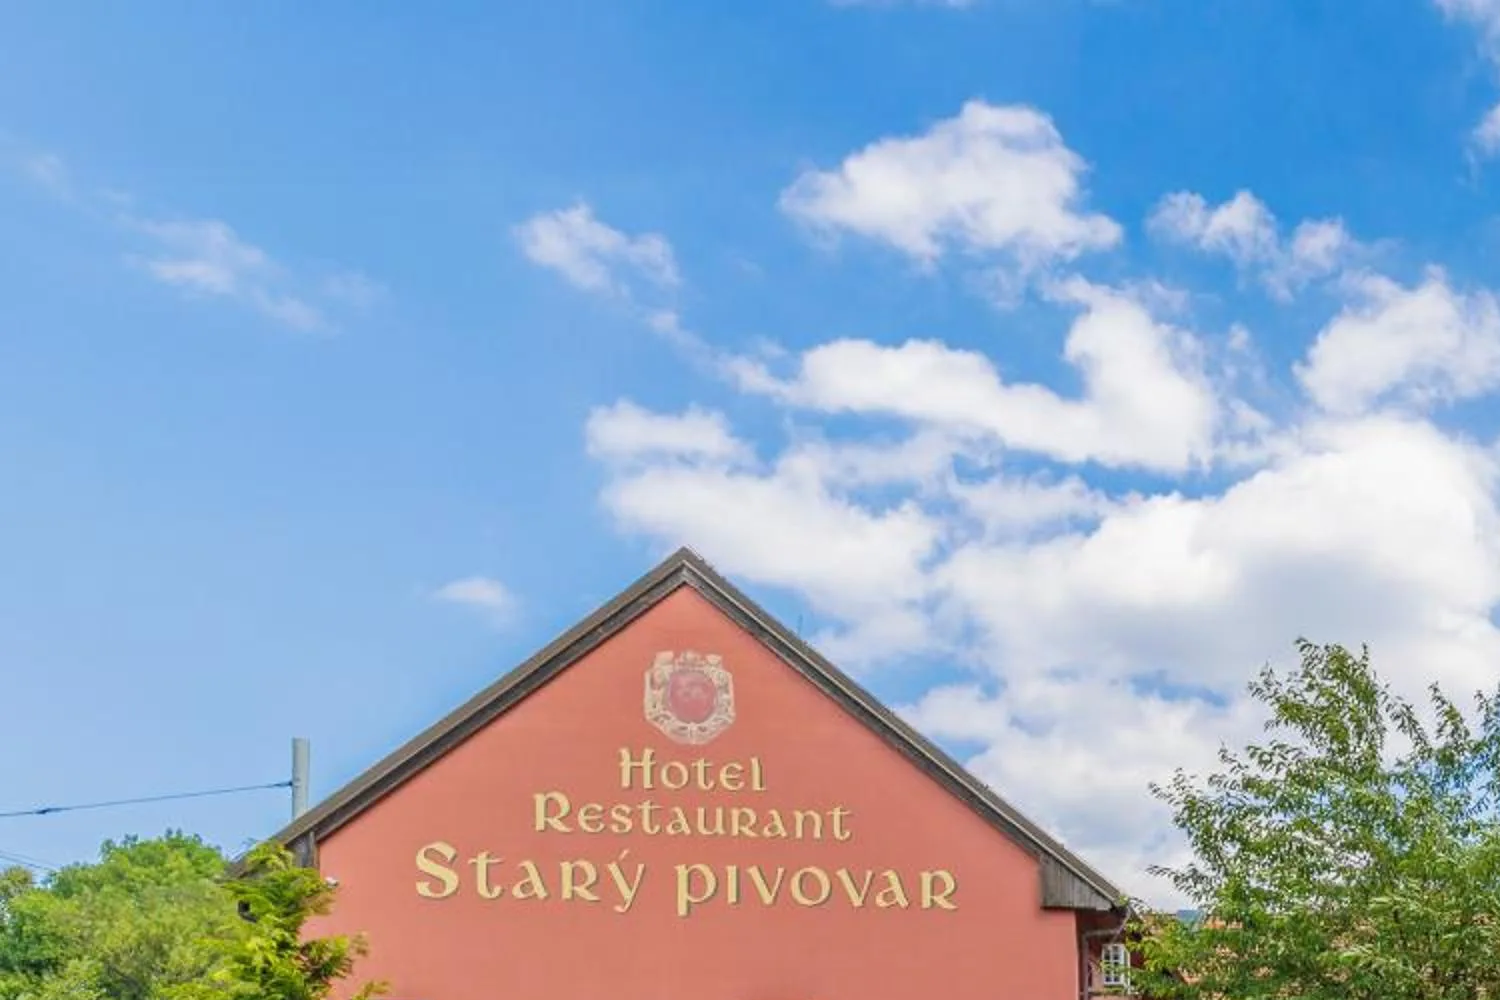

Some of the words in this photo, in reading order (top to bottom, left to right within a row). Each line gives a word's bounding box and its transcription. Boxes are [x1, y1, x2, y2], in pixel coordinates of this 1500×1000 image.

[619, 748, 767, 791] Hotel
[534, 792, 852, 841] Restaurant
[414, 842, 646, 913] Starý
